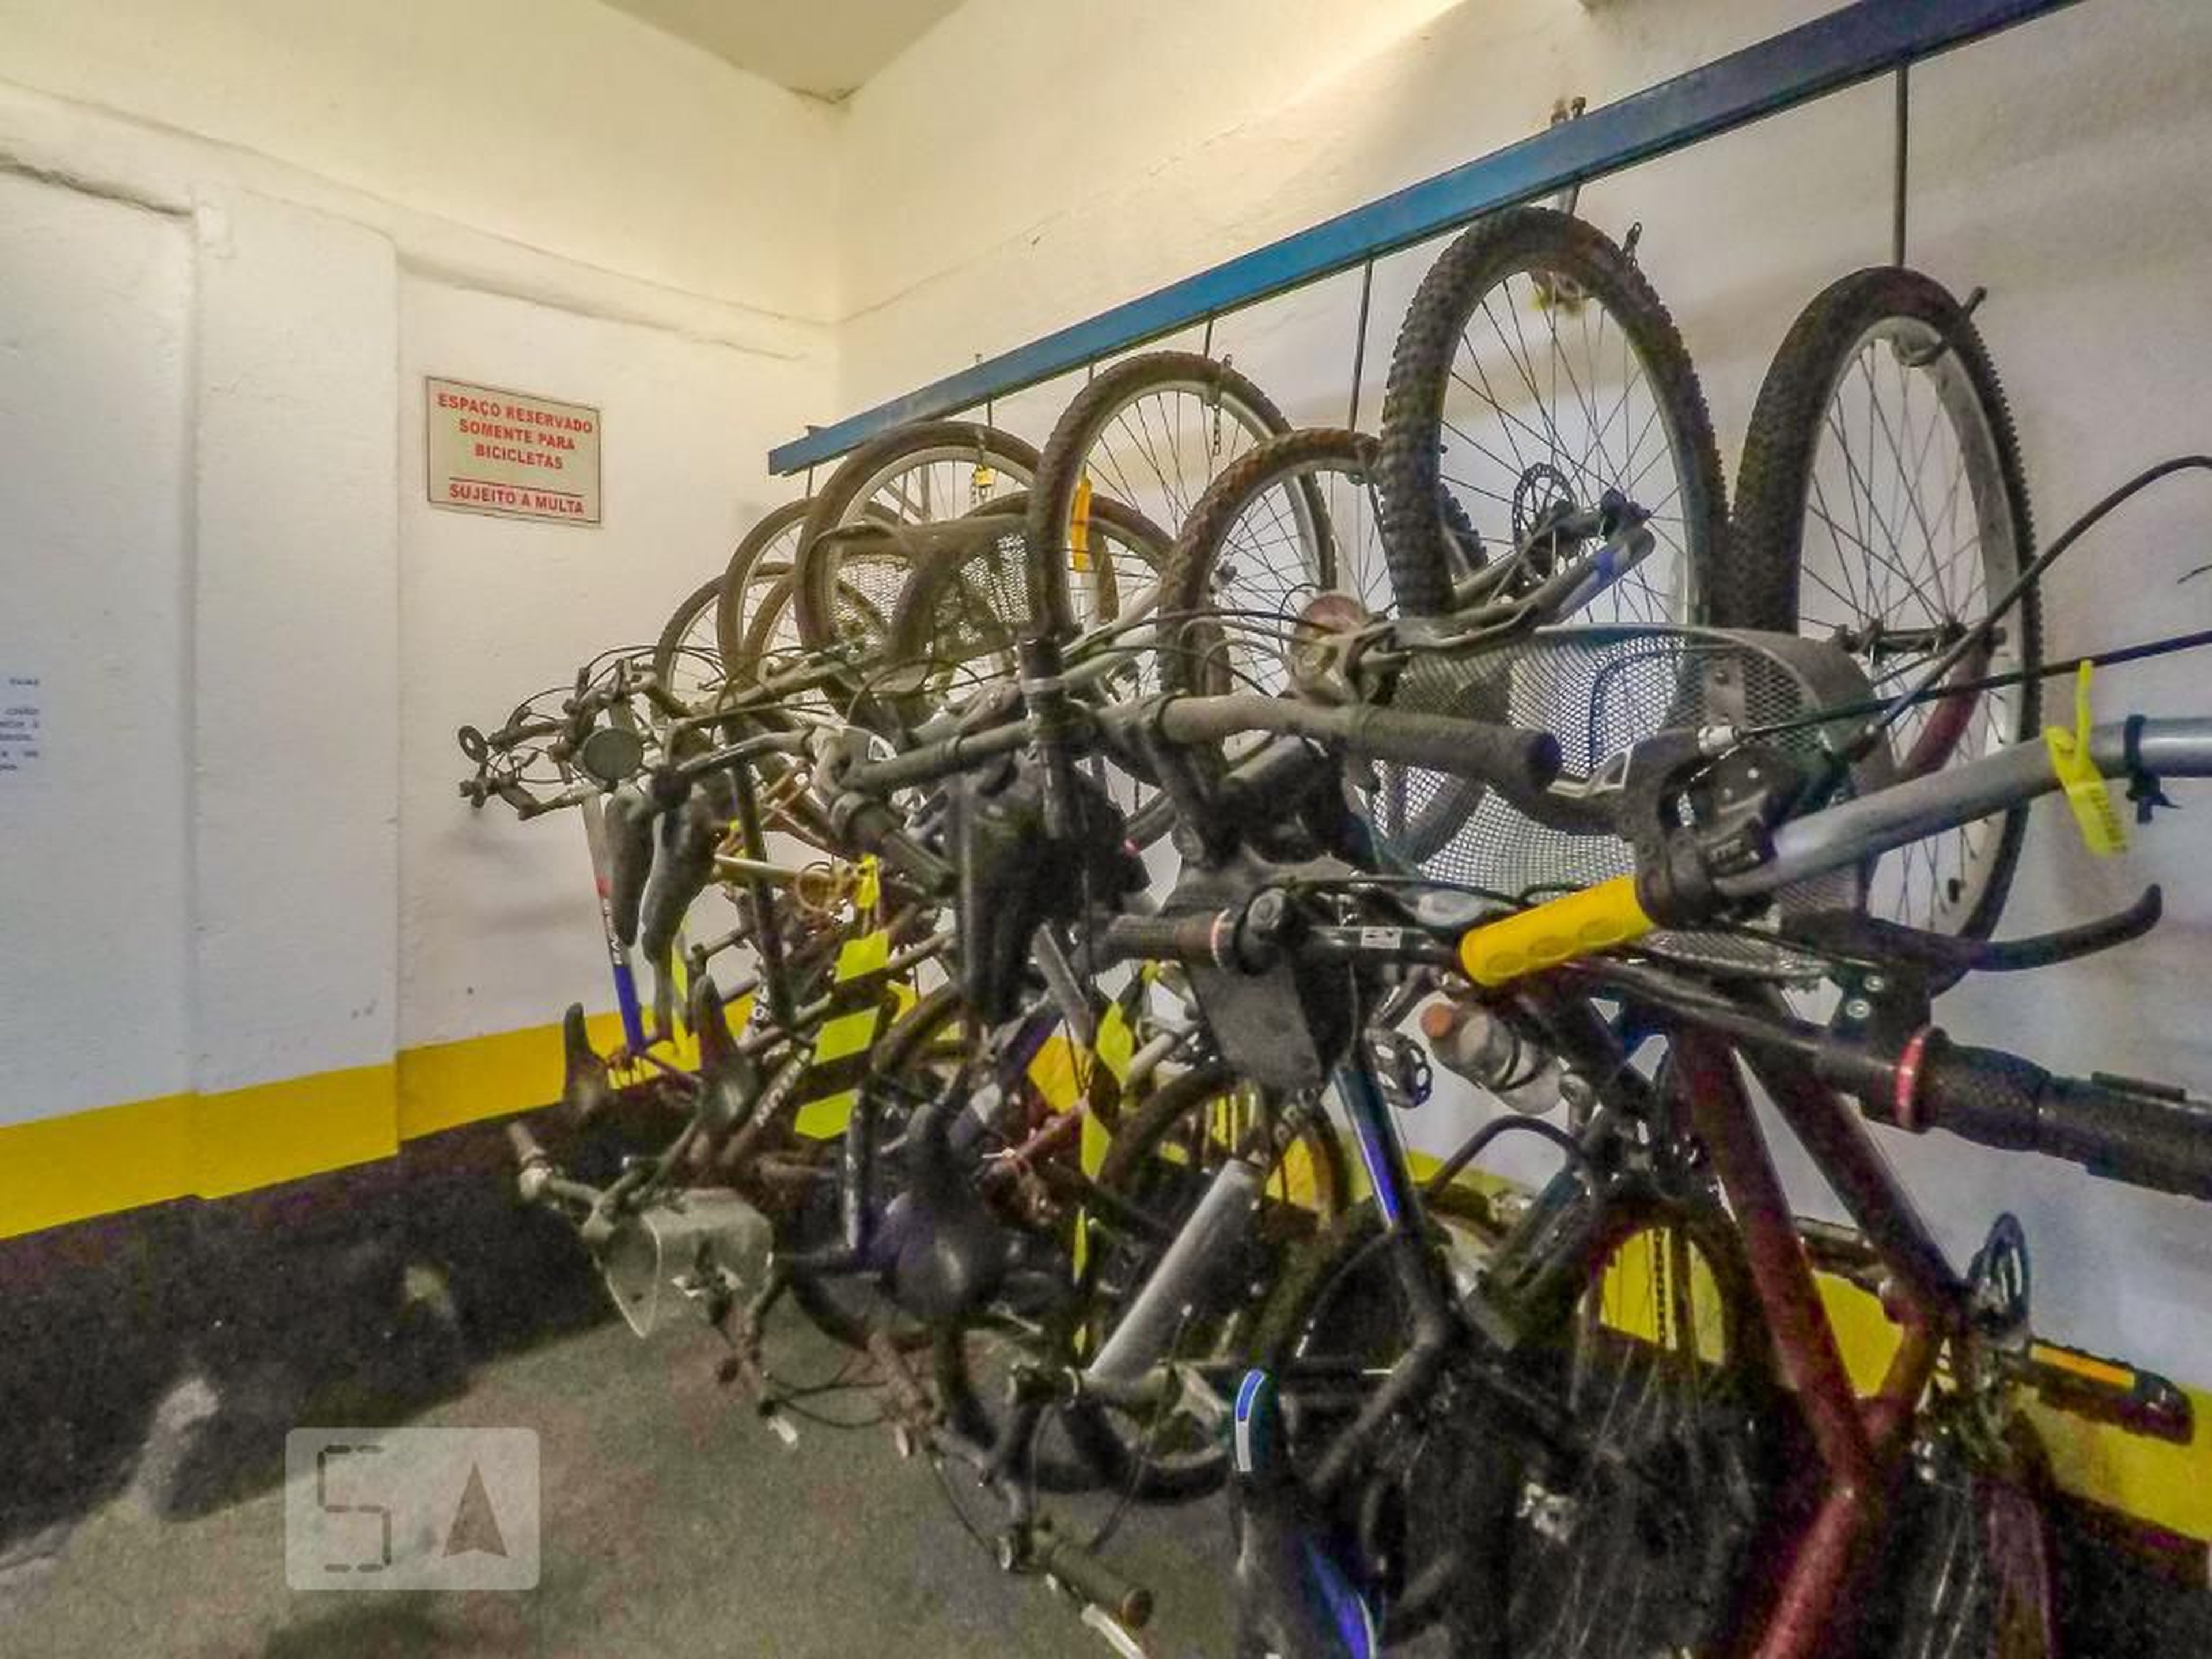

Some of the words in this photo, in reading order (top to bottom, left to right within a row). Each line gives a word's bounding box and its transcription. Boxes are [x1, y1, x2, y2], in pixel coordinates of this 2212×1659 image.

[506, 406, 592, 433] RESERVADO
[459, 419, 532, 443] SOMENTE
[538, 433, 575, 450] PARA
[475, 443, 563, 469] BICICLETAS
[450, 483, 515, 504] SUJEITO
[536, 496, 584, 513] MULTA
